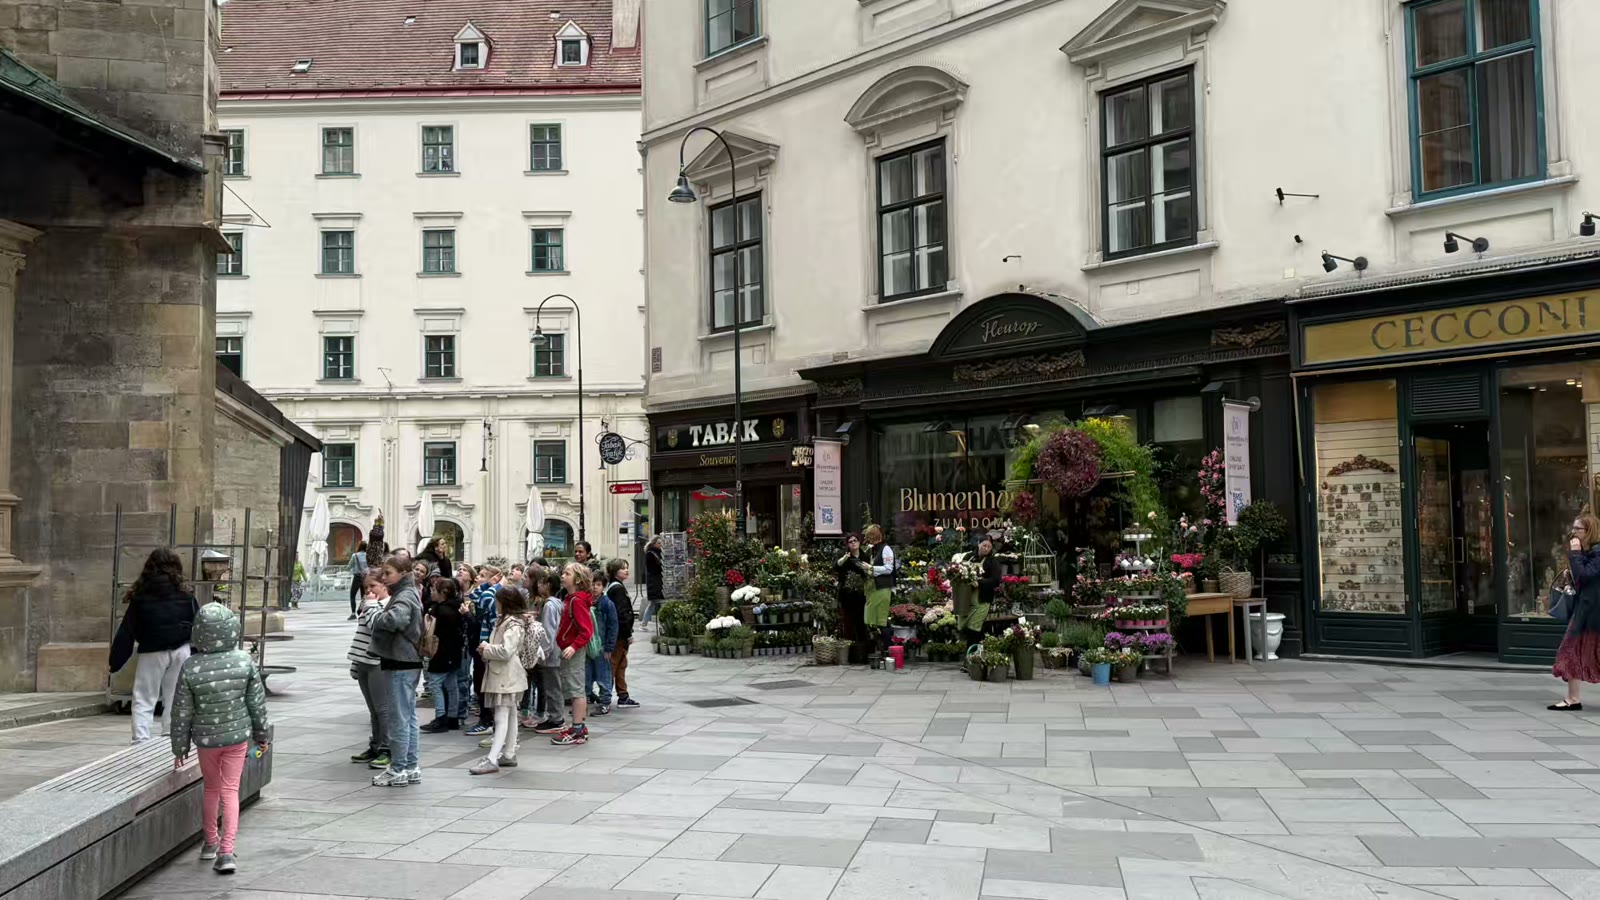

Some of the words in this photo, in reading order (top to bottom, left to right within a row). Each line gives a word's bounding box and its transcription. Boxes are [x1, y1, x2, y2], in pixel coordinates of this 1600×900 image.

[981, 314, 1042, 343] Fleurop
[1371, 296, 1589, 351] CECCONI
[689, 419, 760, 447] TABAK
[699, 454, 737, 467] Souvenir
[900, 484, 1013, 512] Blumenha
[934, 518, 963, 529] ZUM
[971, 517, 1004, 529] DOM
